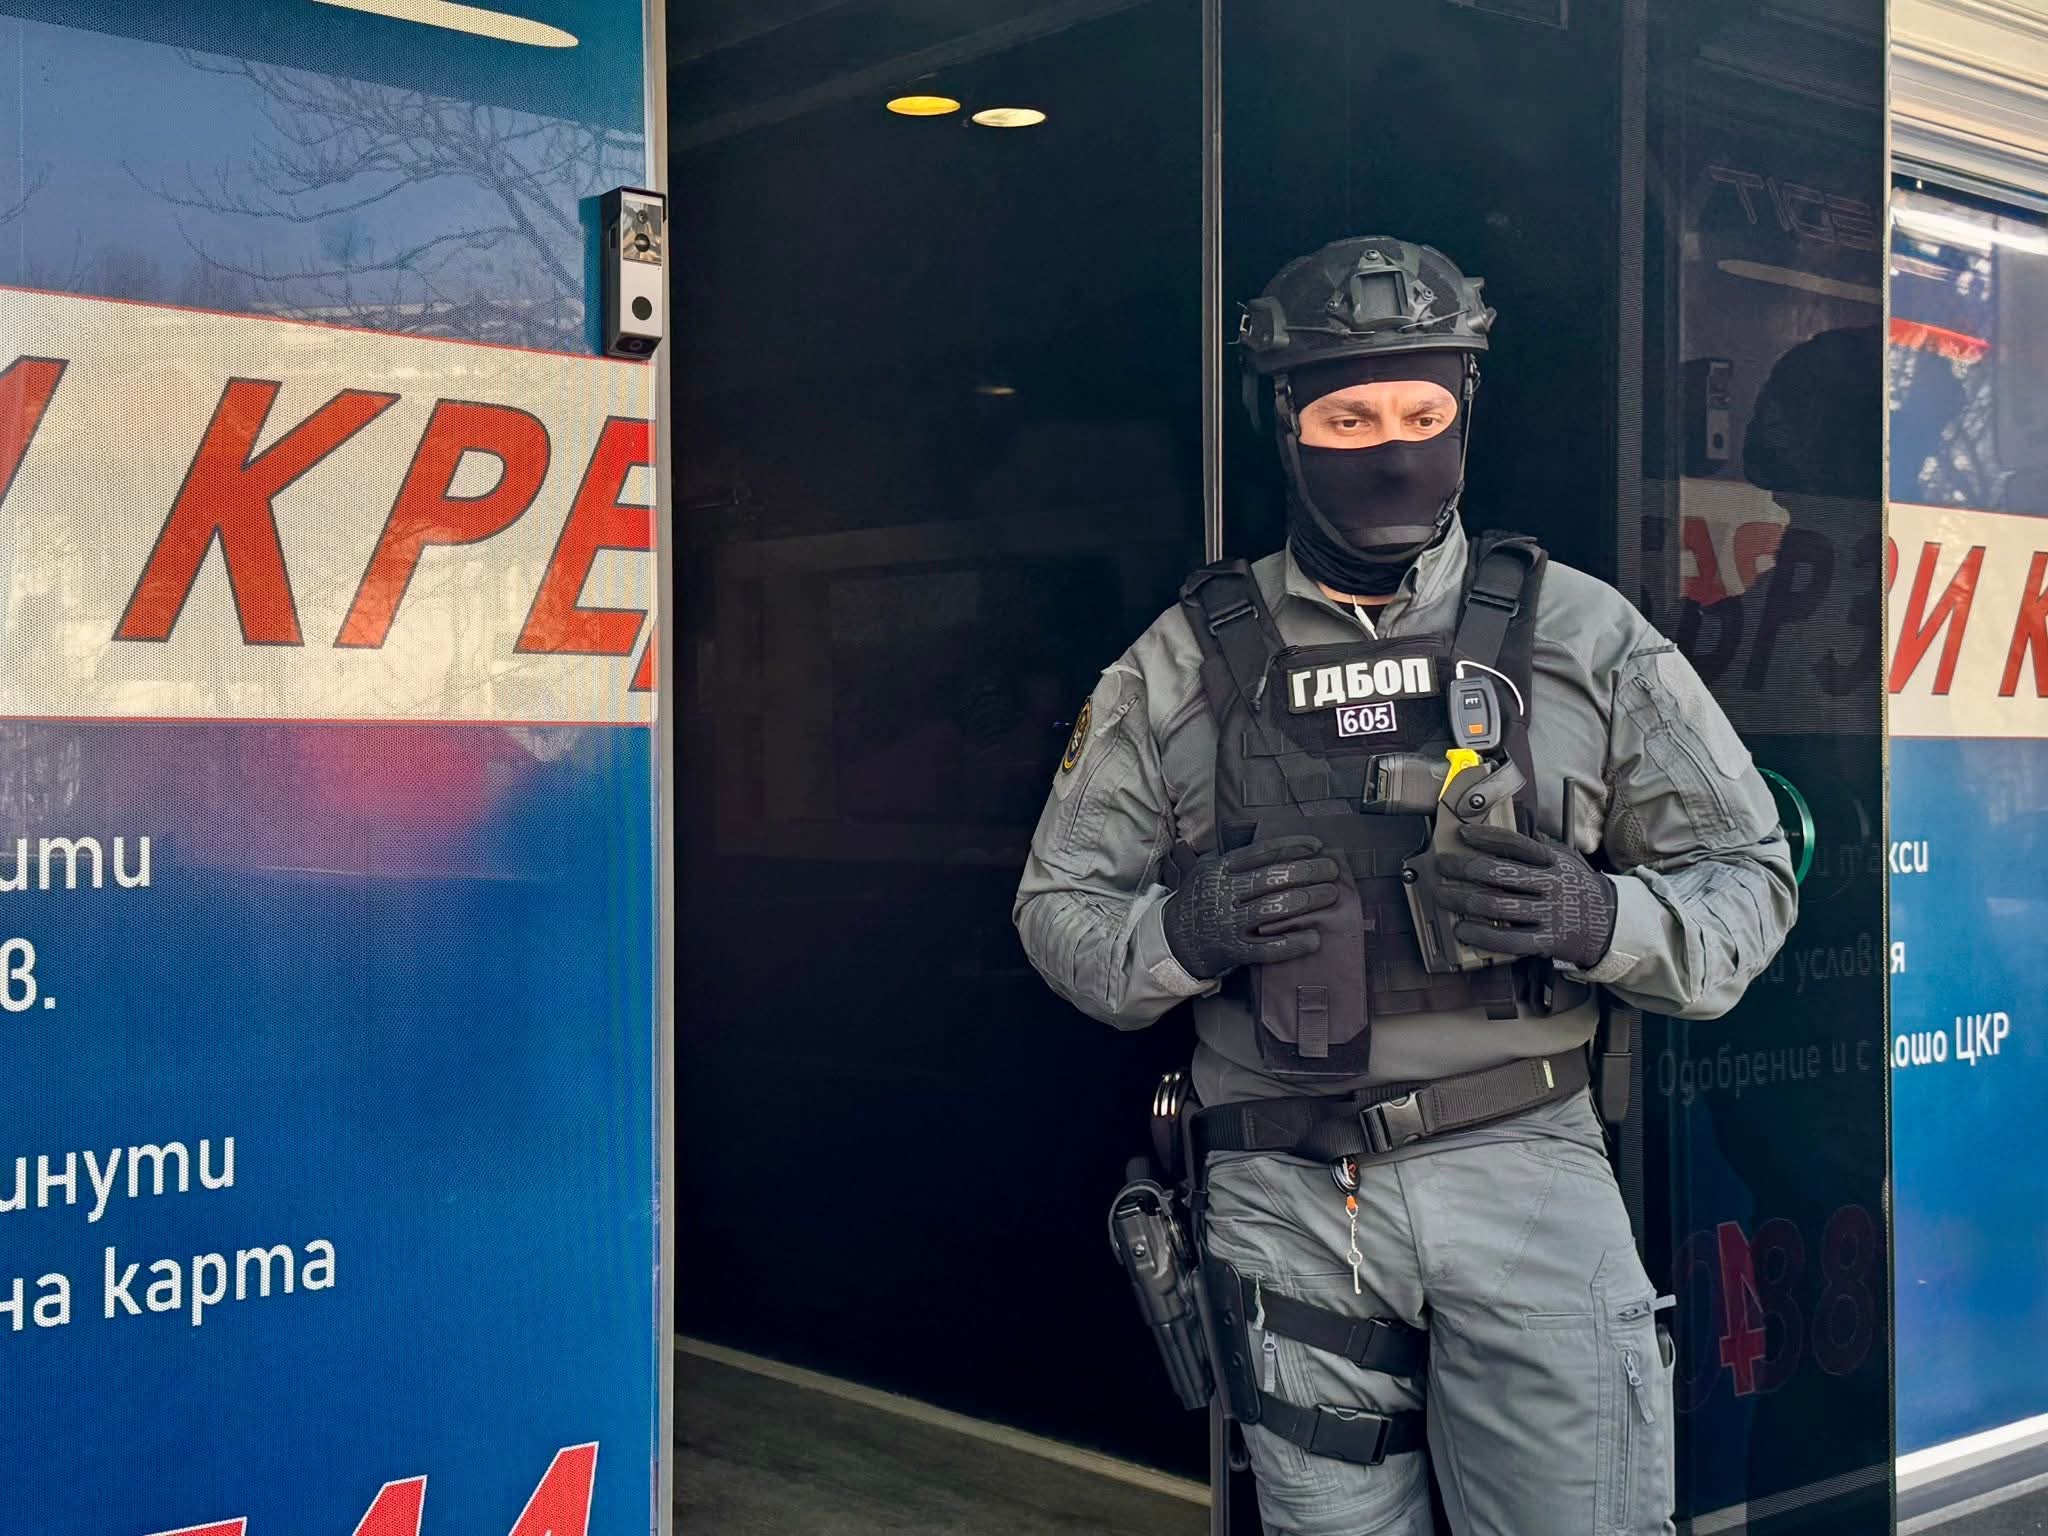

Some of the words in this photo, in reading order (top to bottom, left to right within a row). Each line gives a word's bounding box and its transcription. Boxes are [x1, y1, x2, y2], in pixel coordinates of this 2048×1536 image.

[110, 376, 657, 692] КРЕ
[1292, 658, 1431, 708] ГДБОП
[1342, 709, 1390, 732] 605
[1955, 1011, 2010, 1066] ЦКР
[103, 1238, 336, 1327] карта
